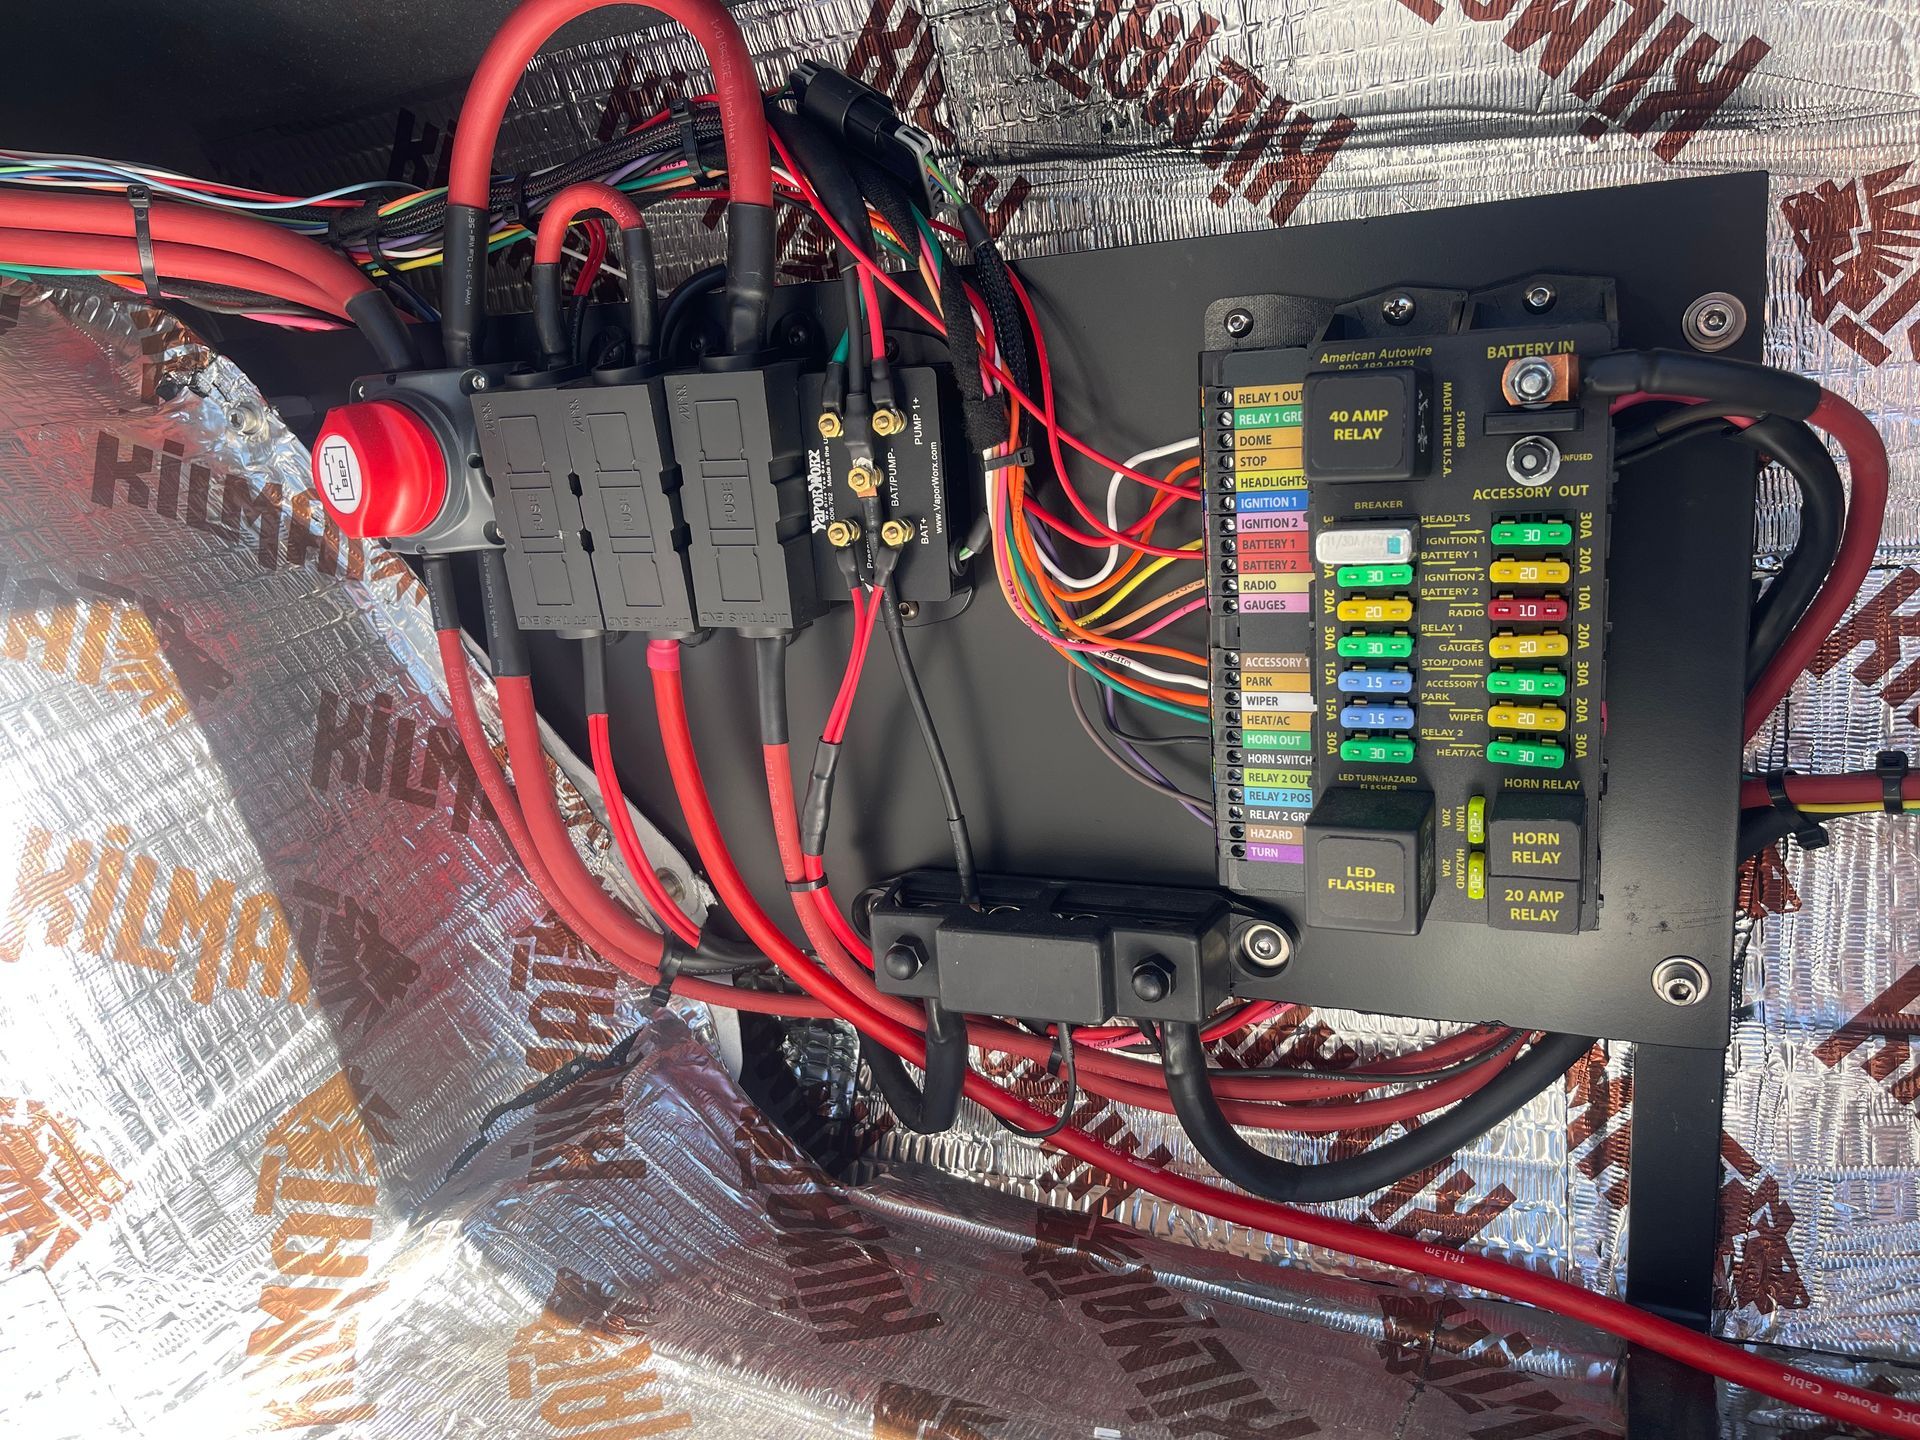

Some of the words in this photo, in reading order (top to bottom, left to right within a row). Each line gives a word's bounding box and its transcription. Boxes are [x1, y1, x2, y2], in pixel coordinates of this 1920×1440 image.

[1320, 349, 1376, 364] American
[1378, 345, 1433, 360] Autowire
[1487, 342, 1554, 359] BATTERY
[1558, 340, 1575, 353] IN
[912, 397, 921, 410] 1+
[1239, 392, 1271, 405] RELAY
[1274, 392, 1279, 402] 1
[1282, 390, 1304, 401] OUT
[1443, 382, 1452, 412] MADE
[1239, 413, 1271, 425] RELAY
[1274, 413, 1279, 423] 1
[1329, 410, 1349, 423] 40
[1352, 409, 1389, 423] AMP
[1443, 415, 1452, 425] IN
[913, 413, 923, 445] PUMP
[1333, 428, 1383, 441] RELAY
[1240, 435, 1272, 446] DOME
[1443, 427, 1452, 447] THE
[1240, 456, 1267, 467] STOP
[1443, 449, 1452, 477] U.S.A.
[338, 460, 349, 488] BEP
[887, 447, 900, 507] BAT/PUMP-
[930, 441, 943, 534] www.VaporWorx.com
[1241, 475, 1308, 488] HEADLIGHTS
[1472, 486, 1552, 500] ACCESSORY
[1559, 484, 1589, 497] OUT
[721, 482, 738, 524] FUSE
[1241, 498, 1289, 509] IGNITION
[1293, 497, 1297, 507] 1
[1354, 500, 1404, 510] BREAKER
[1241, 519, 1290, 529] IGNITION
[1292, 518, 1298, 528] 2
[1420, 513, 1471, 523] HEADLTS
[920, 517, 930, 545] BAT+
[1580, 512, 1593, 539] 30A
[1426, 537, 1478, 545] IGNITION
[1523, 529, 1540, 542] 30
[1242, 539, 1287, 549] BATTERY
[1421, 551, 1470, 560] BATTERY
[1579, 548, 1592, 574] 20A
[1243, 560, 1288, 571] BATTERY
[1291, 560, 1297, 569] 2
[1366, 570, 1384, 583] 30
[1424, 573, 1476, 582] IGNITION
[1479, 573, 1485, 581] 2
[1519, 567, 1538, 580] 20
[1243, 580, 1277, 591] RADIO
[1421, 588, 1469, 596] BATTERY
[1473, 587, 1479, 596] 2
[1324, 589, 1336, 614] 20A
[1578, 586, 1591, 611] 10A
[1244, 600, 1286, 611] GAUGES
[1365, 606, 1382, 618] 20
[1519, 604, 1536, 617] 10
[1448, 609, 1485, 617] RADIO
[1421, 624, 1455, 632] RELAY
[1325, 626, 1336, 651] 30A
[1577, 623, 1590, 649] 20A
[1367, 643, 1384, 655] 30
[1439, 644, 1485, 652] GAUGES
[1519, 641, 1536, 653] 20
[1245, 657, 1302, 668] ACCESSORY
[1421, 659, 1484, 667] STOP/DOME
[1325, 662, 1336, 685] 15A
[1576, 661, 1589, 687] 30A
[1246, 676, 1272, 687] PARK
[1366, 676, 1383, 688] 15
[1426, 680, 1477, 688] ACCESSORY
[1518, 679, 1535, 692] 30
[1246, 696, 1279, 706] WIPER
[1421, 693, 1450, 701] PARK
[1326, 698, 1337, 721] 15A
[1576, 698, 1588, 723] 20A
[1247, 715, 1291, 726] HEAT/AC
[1369, 713, 1385, 725] 15
[1449, 714, 1484, 722] WIPER
[1518, 713, 1535, 725] 20
[1457, 729, 1464, 737] 2
[1247, 734, 1277, 745] HORN
[1279, 735, 1301, 746] OUT
[1326, 731, 1338, 755] 30A
[1575, 733, 1588, 758] 30A
[1247, 754, 1276, 764] HORN
[1277, 755, 1313, 766] SWITCH
[1369, 748, 1386, 760] 30
[1436, 749, 1484, 758] HEAT/AC
[1518, 750, 1535, 763] 30
[1249, 773, 1279, 782] RELAY
[1282, 774, 1288, 783] 2
[1290, 774, 1312, 784] OUT
[1338, 773, 1355, 782] LED
[1356, 774, 1418, 784] TURN/HAZARD
[1504, 778, 1539, 789] HORN
[1543, 779, 1581, 790] RELAY
[1249, 791, 1280, 801] RELAY
[1282, 792, 1288, 802] 2
[1290, 793, 1311, 803] POS
[1250, 810, 1280, 820] RELAY
[1283, 811, 1289, 821] 2
[1442, 808, 1450, 827] 20A
[1456, 804, 1465, 832] TURN
[1470, 817, 1481, 833] 20
[1250, 829, 1293, 840] HAZARD
[1512, 832, 1560, 845] HORN
[1251, 847, 1279, 858] TURN
[1512, 851, 1562, 865] RELAY
[1346, 866, 1376, 879] LED
[1442, 859, 1450, 877] 20A
[1456, 848, 1465, 889] HAZARD
[1328, 879, 1396, 894] FLASHER
[1470, 873, 1481, 889] 20
[1504, 889, 1524, 901] 20
[1527, 890, 1565, 903] AMP
[1510, 908, 1559, 922] RELAY
[1302, 1072, 1346, 1081] GROUND
[1782, 1372, 1823, 1395] Cable
[1833, 1389, 1880, 1414] Power
